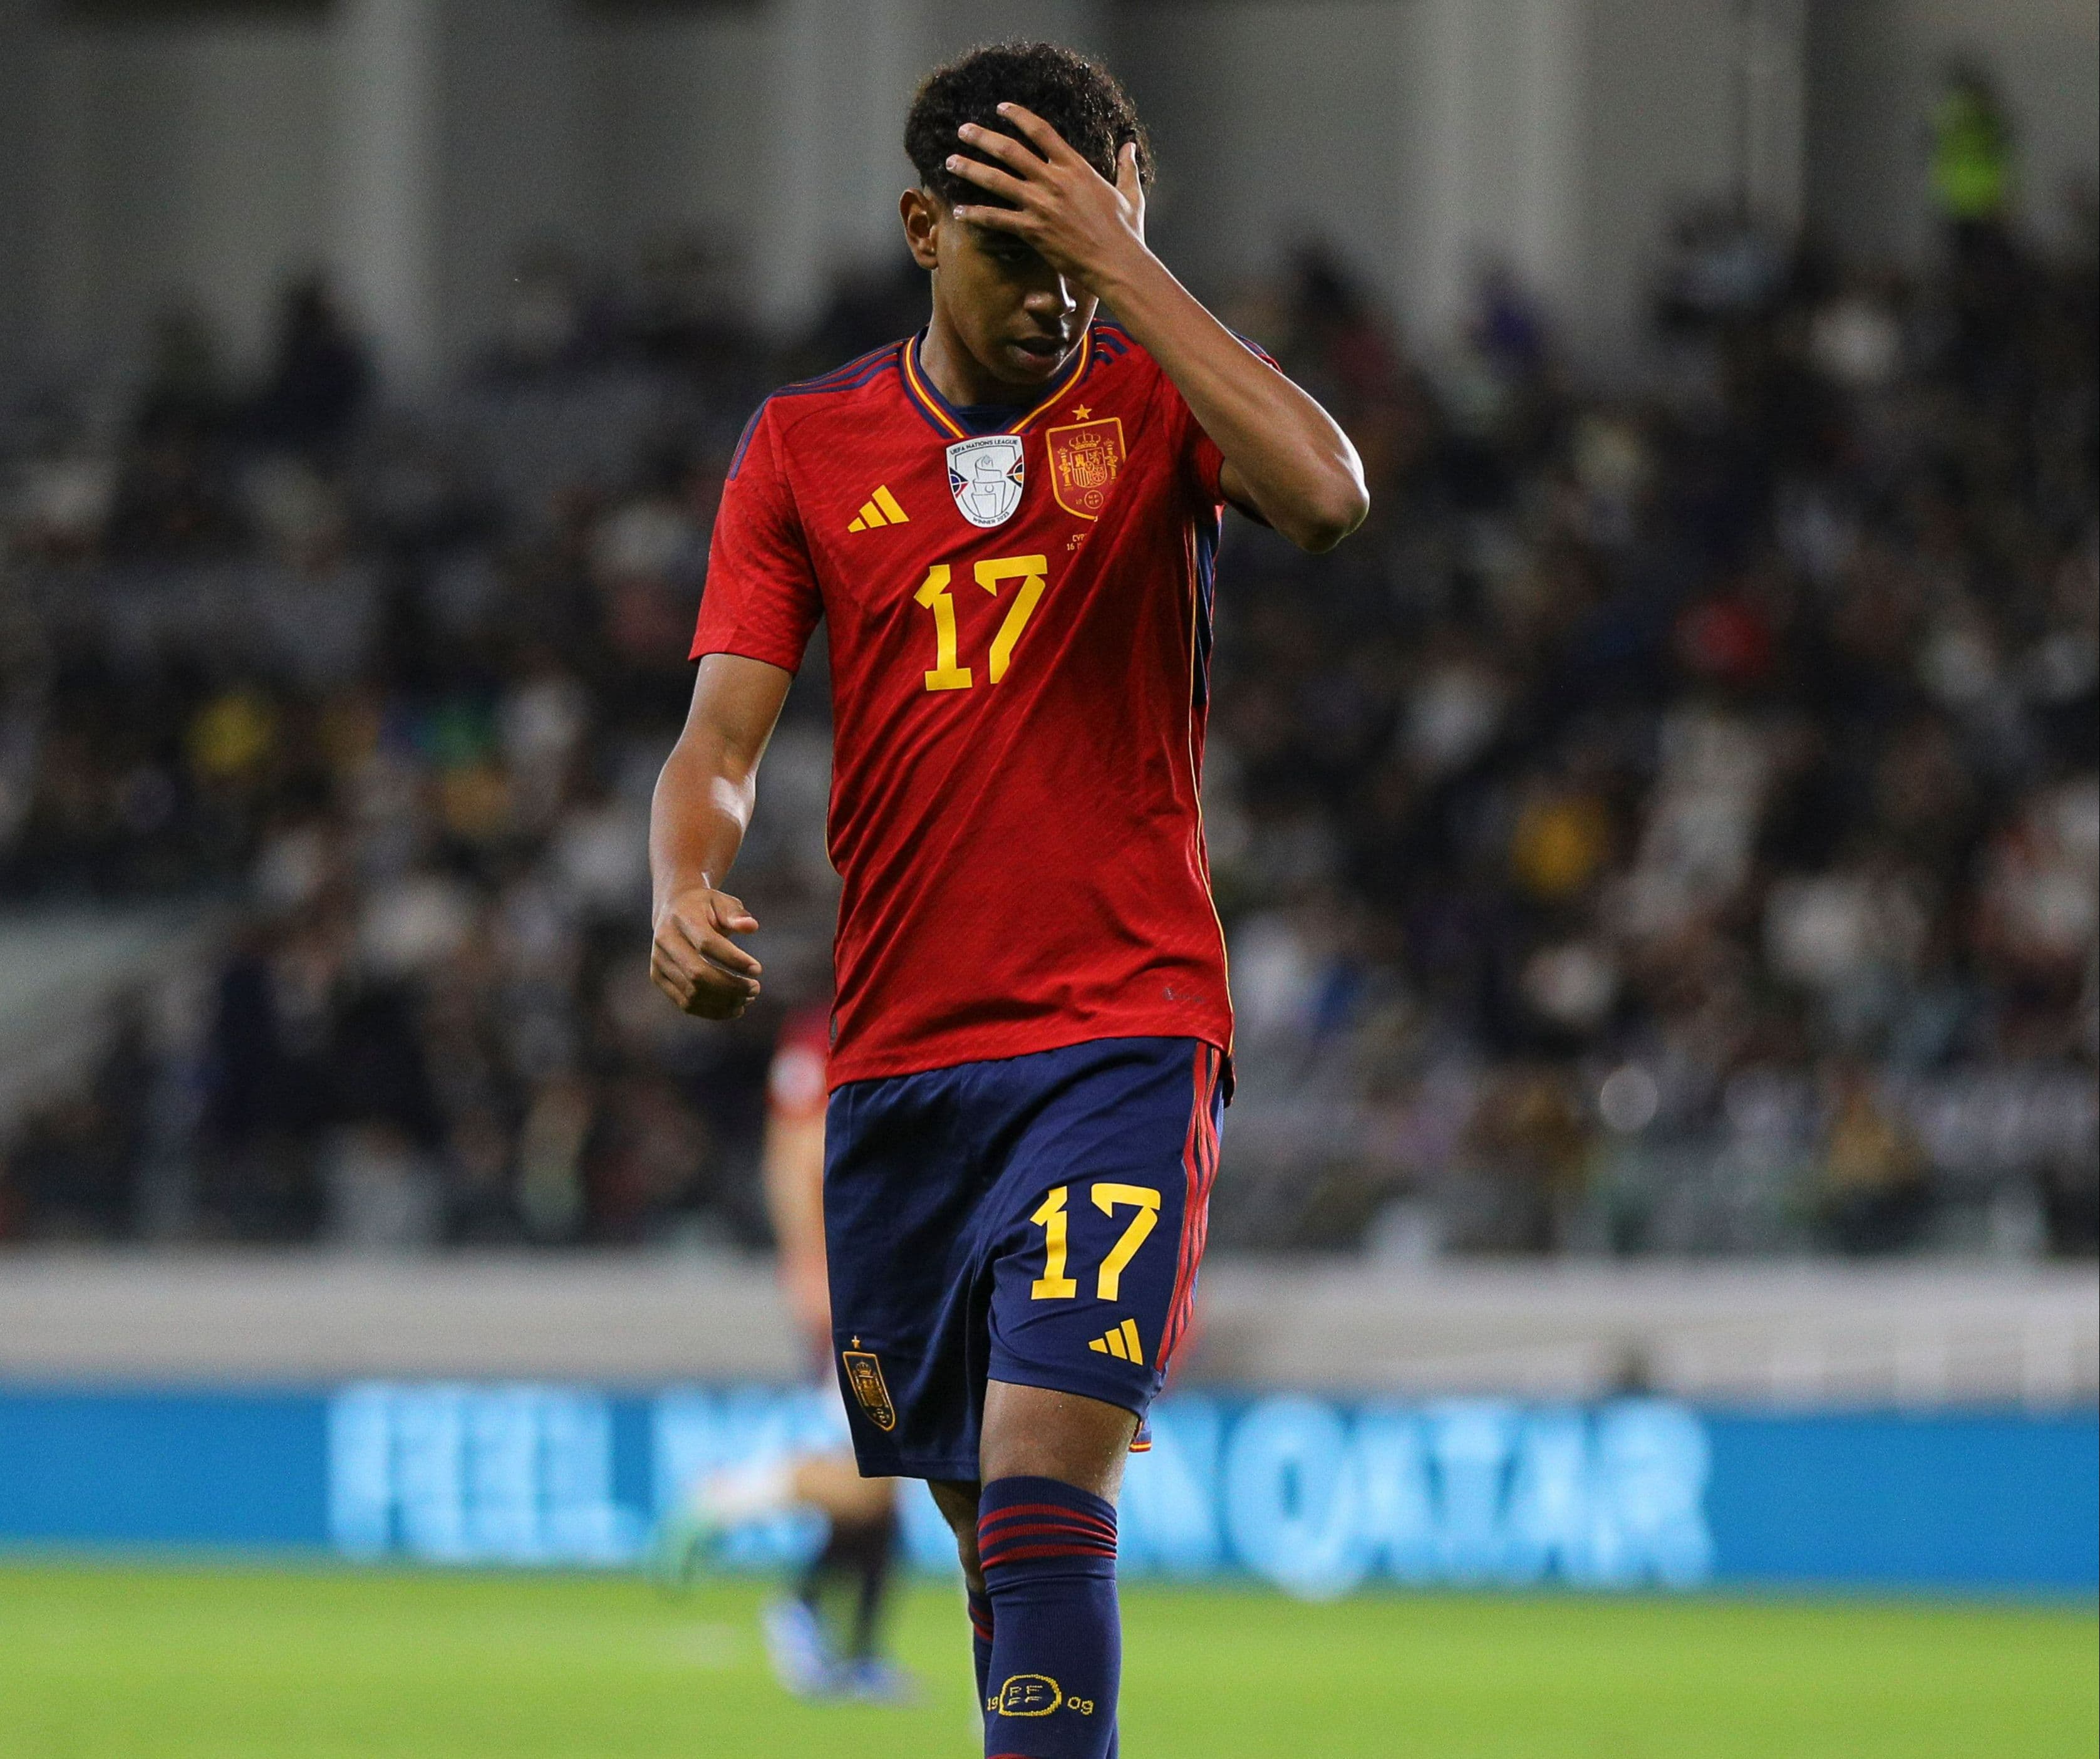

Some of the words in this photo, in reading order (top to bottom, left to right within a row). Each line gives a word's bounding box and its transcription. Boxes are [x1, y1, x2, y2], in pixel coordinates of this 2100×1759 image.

[950, 446, 965, 455] UEFA
[966, 440, 993, 449] NATIONS
[973, 517, 996, 525] WINNER
[997, 512, 1010, 522] 2023
[1072, 533, 1087, 542] CYP
[913, 554, 1048, 691] 17
[1030, 1183, 1161, 1302] 17
[1224, 1390, 1714, 1601] QATAR
[987, 1696, 998, 1711] 19
[1067, 1696, 1094, 1715] 09
